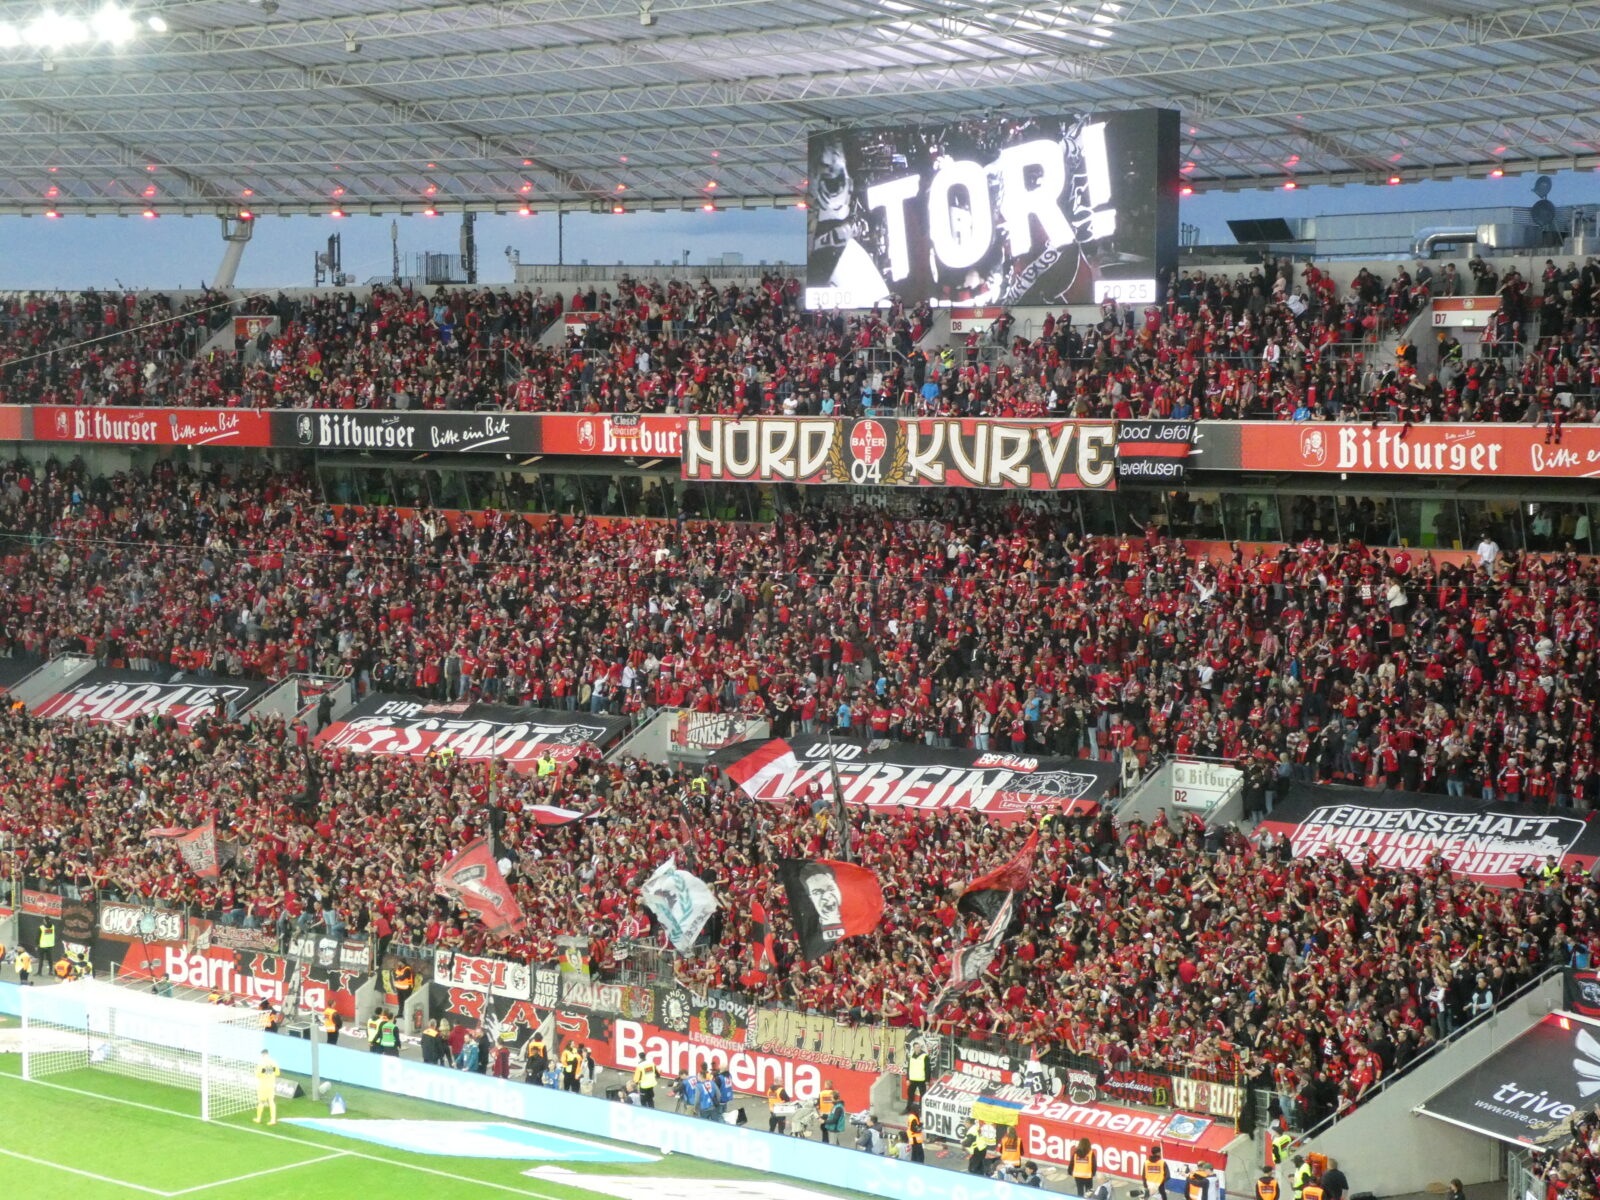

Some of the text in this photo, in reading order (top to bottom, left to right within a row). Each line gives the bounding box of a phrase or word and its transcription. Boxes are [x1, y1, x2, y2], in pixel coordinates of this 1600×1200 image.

[866, 121, 1117, 282] TOR!
[1435, 313, 1447, 325] D7
[75, 410, 157, 441] Bitburger
[199, 423, 217, 435] ein
[219, 412, 239, 431] Bit
[319, 414, 415, 448] Bitburger
[430, 416, 510, 447] Bitte ein Bit
[1155, 424, 1192, 440] Jeföl
[688, 418, 836, 480] NORD
[907, 421, 1114, 487] KURVE
[1337, 427, 1502, 471] Bitburger
[1532, 443, 1580, 472] Bitte
[851, 459, 882, 484] 04
[375, 700, 424, 718] FÜR
[389, 718, 563, 759] STADT
[805, 742, 863, 760] UND
[1175, 789, 1187, 802] D2
[1310, 807, 1556, 836] LEIDENSCHAFT
[1296, 823, 1492, 859] EMOTIONEN
[454, 955, 508, 990] FSI
[535, 981, 559, 995] SIDE
[718, 999, 748, 1019] BOYZ
[957, 1047, 1010, 1070] YOUNG
[924, 1099, 972, 1116] GEHT MIR AUF
[1493, 1082, 1576, 1119] trive
[925, 1111, 953, 1136] DEN
